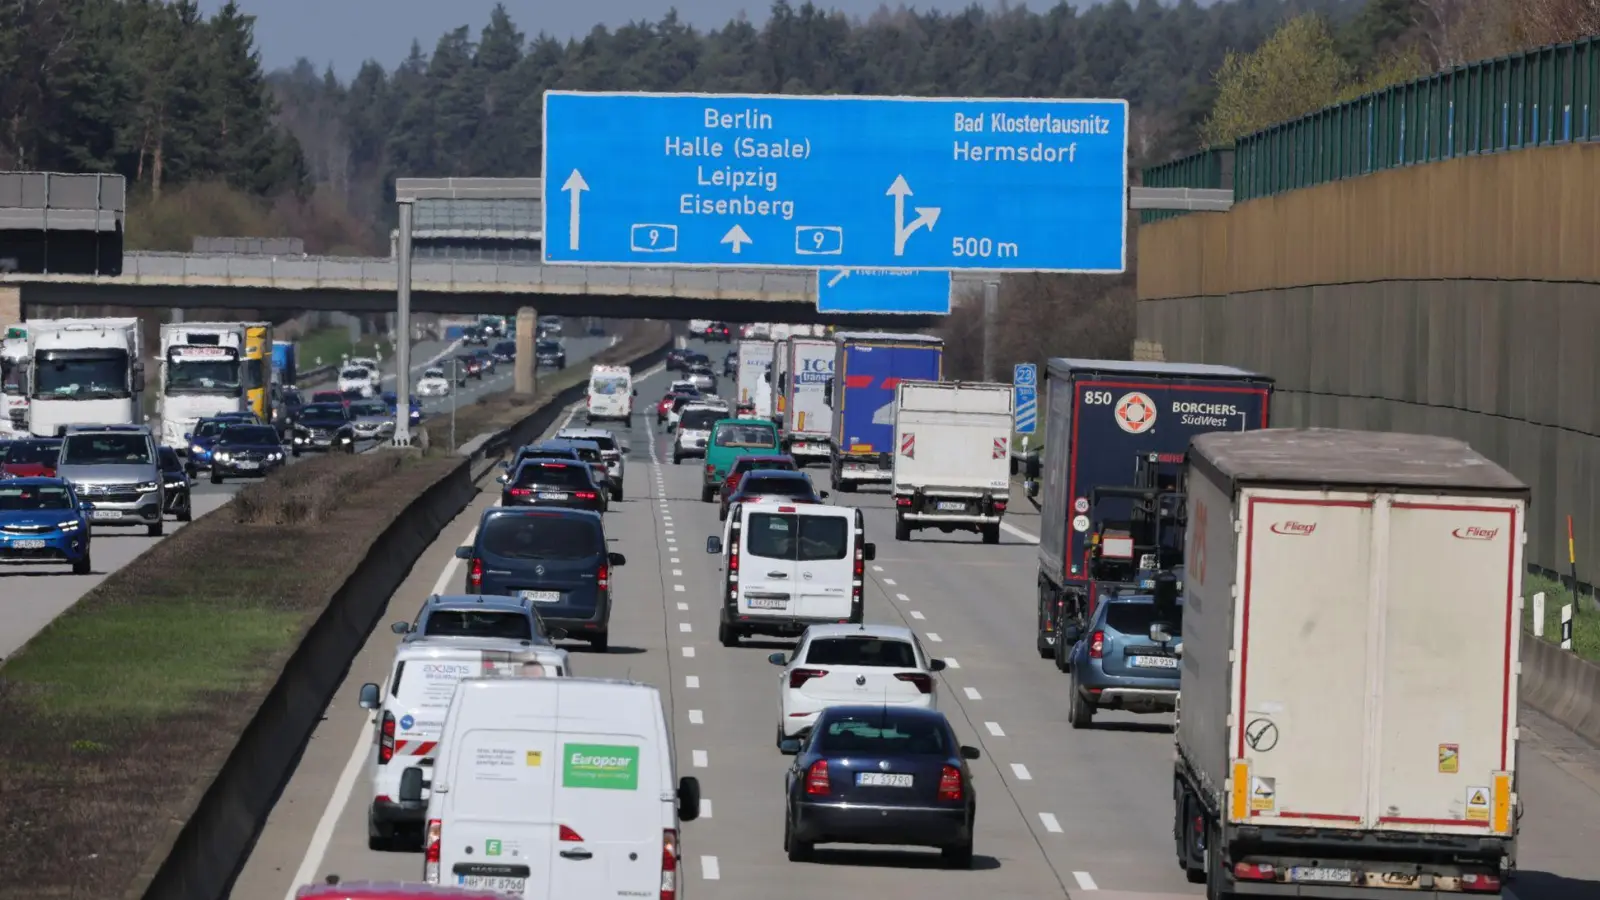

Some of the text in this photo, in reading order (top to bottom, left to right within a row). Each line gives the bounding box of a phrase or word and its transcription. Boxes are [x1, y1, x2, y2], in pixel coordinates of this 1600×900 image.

[704, 107, 772, 129] Berlin
[954, 112, 1110, 135] Bad Klosterlausnitz
[665, 136, 811, 160] Halle (Saale)
[953, 141, 1077, 163] Hermsdorf
[697, 166, 777, 192] Leipzig
[680, 193, 794, 221] Eisenberg
[649, 229, 660, 247] 9
[812, 231, 825, 249] 9
[952, 236, 1018, 257] 500 m
[1084, 390, 1112, 406] 850
[1172, 401, 1237, 416] BORCHERS
[1181, 414, 1228, 427] SüdWest
[1284, 520, 1317, 536] Fliegl
[1466, 526, 1499, 540] Fliegl
[423, 664, 470, 674] axians
[571, 752, 633, 769] Europcar
[488, 841, 499, 852] E
